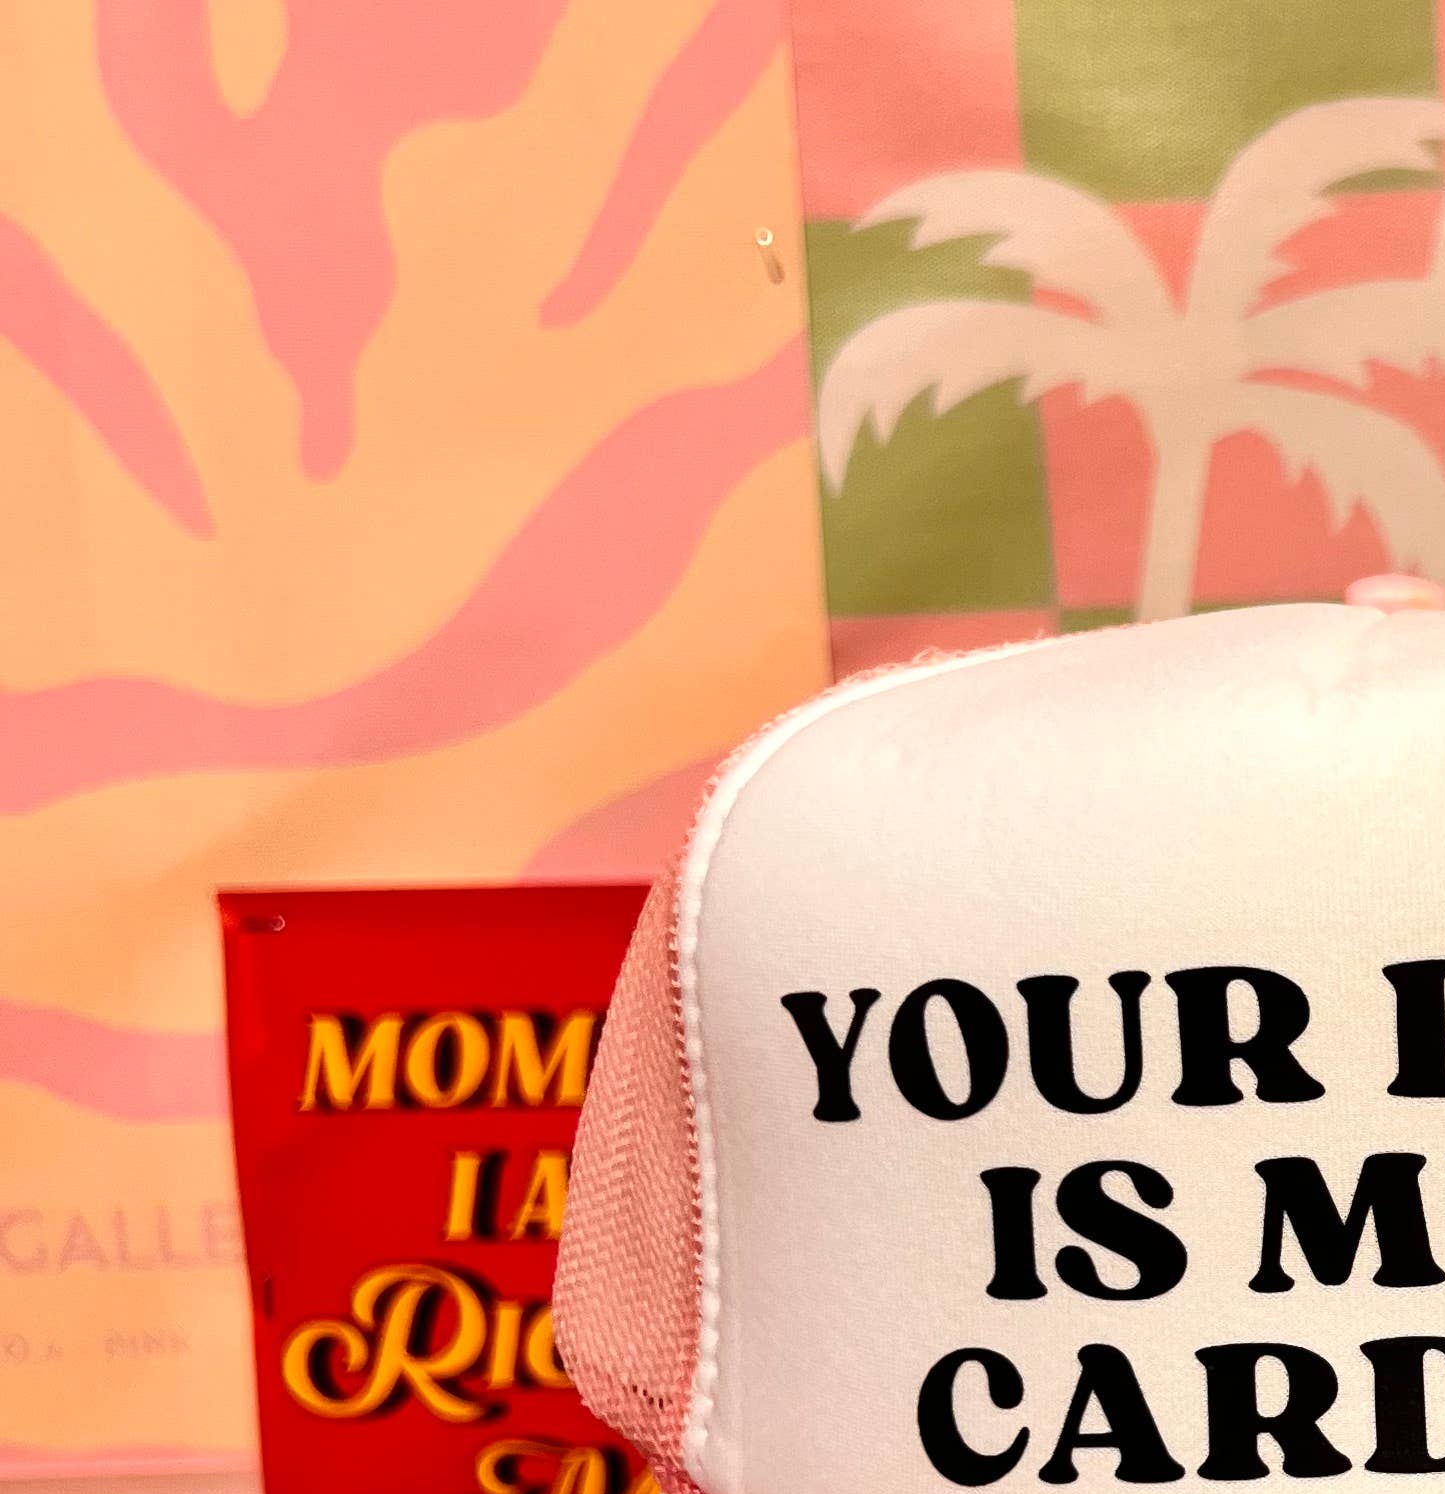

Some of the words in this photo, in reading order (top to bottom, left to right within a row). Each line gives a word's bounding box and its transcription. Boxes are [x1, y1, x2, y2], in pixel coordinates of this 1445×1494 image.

[781, 967, 1325, 1122] YOUR
[446, 1150, 482, 1240] I
[980, 1161, 1187, 1300] IS
